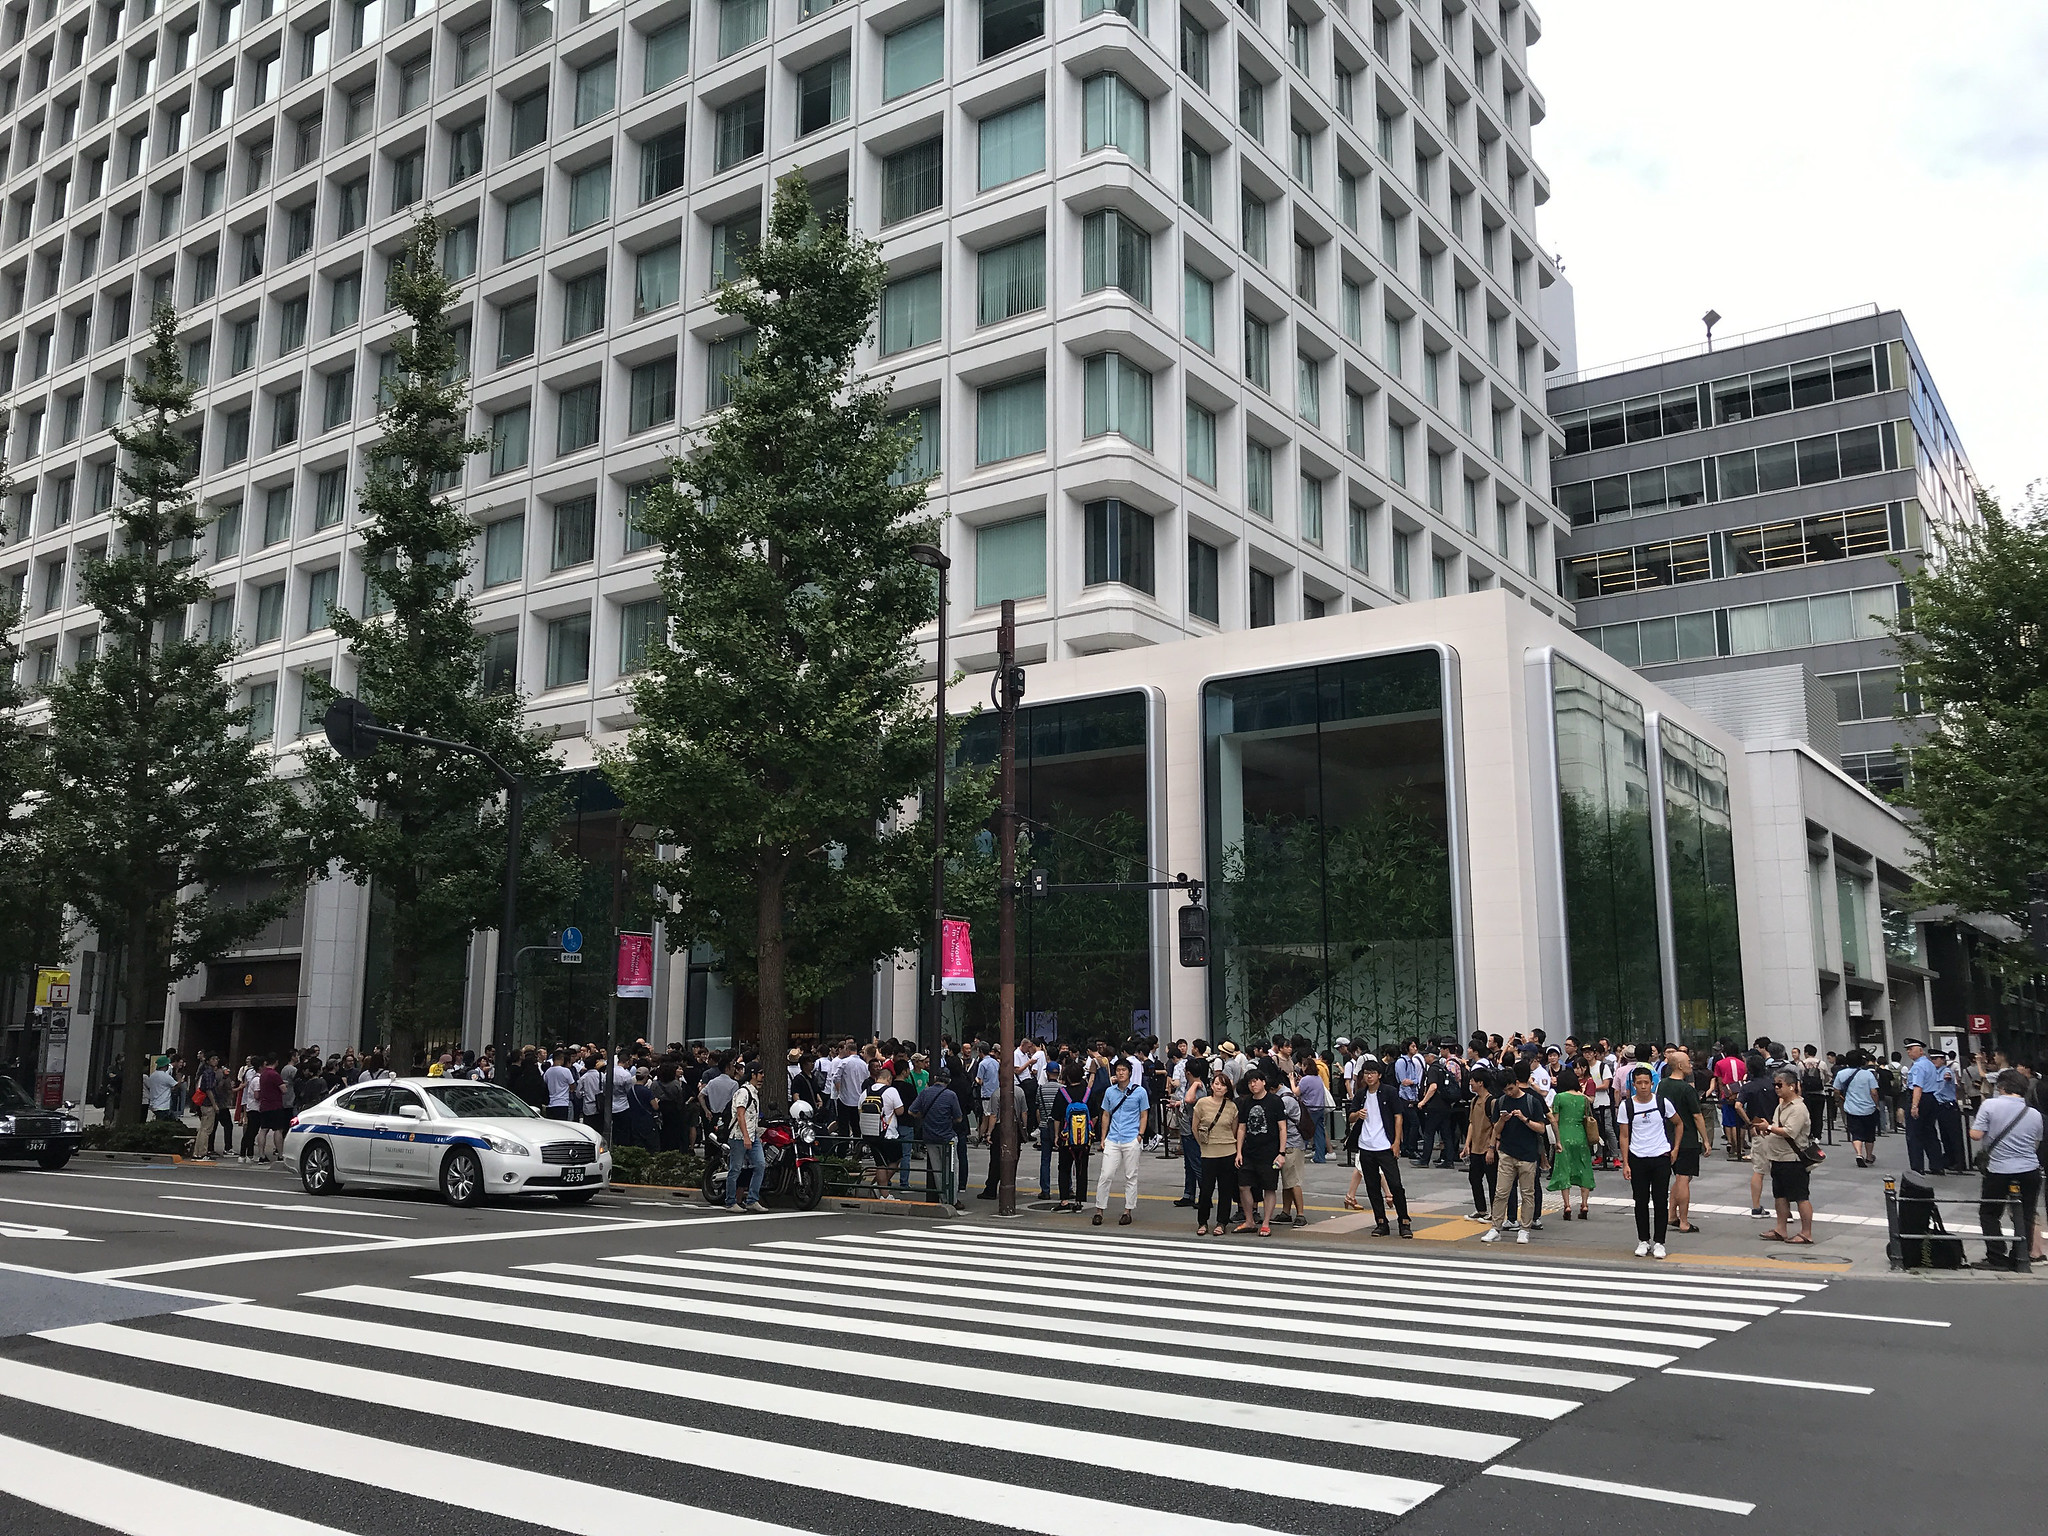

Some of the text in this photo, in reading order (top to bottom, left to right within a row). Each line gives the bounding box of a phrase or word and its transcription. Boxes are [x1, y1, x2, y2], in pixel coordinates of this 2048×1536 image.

[57, 989, 62, 997] 1
[1974, 1017, 1986, 1028] P
[566, 1173, 584, 1182] 22-58
